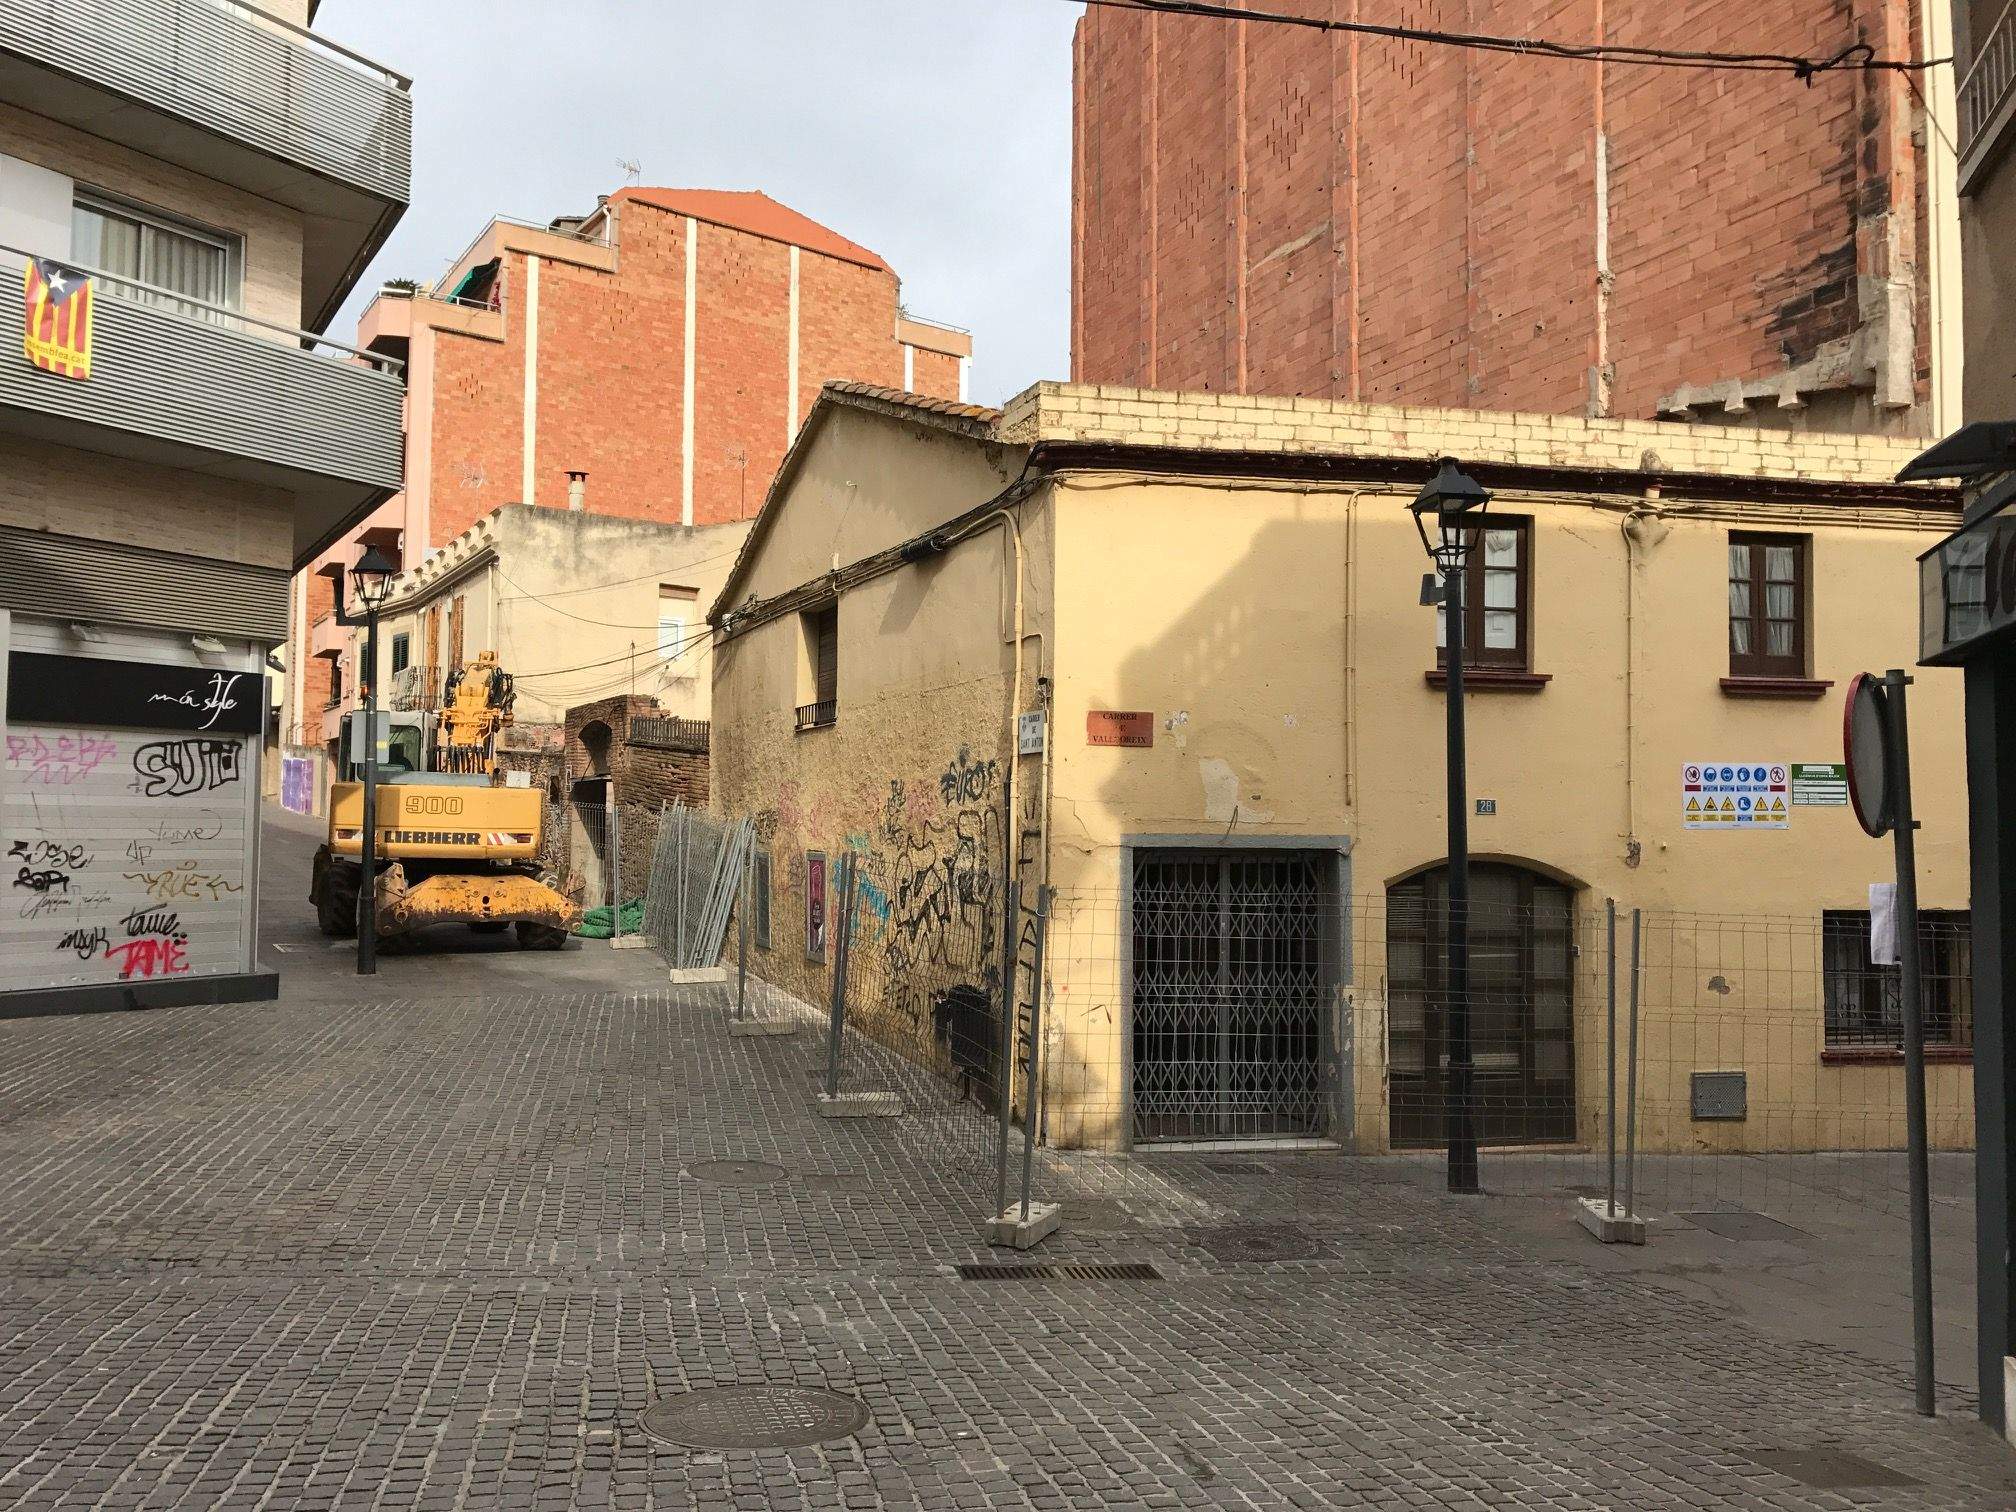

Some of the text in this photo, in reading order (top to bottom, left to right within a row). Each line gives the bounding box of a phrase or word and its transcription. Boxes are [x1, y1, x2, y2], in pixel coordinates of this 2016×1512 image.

[198, 673, 242, 729] style
[1103, 712, 1138, 721] CARRER
[406, 795, 464, 815] 900
[1480, 800, 1492, 812] 28
[384, 830, 482, 846] LIEBHERR
[104, 938, 190, 978] TAME
